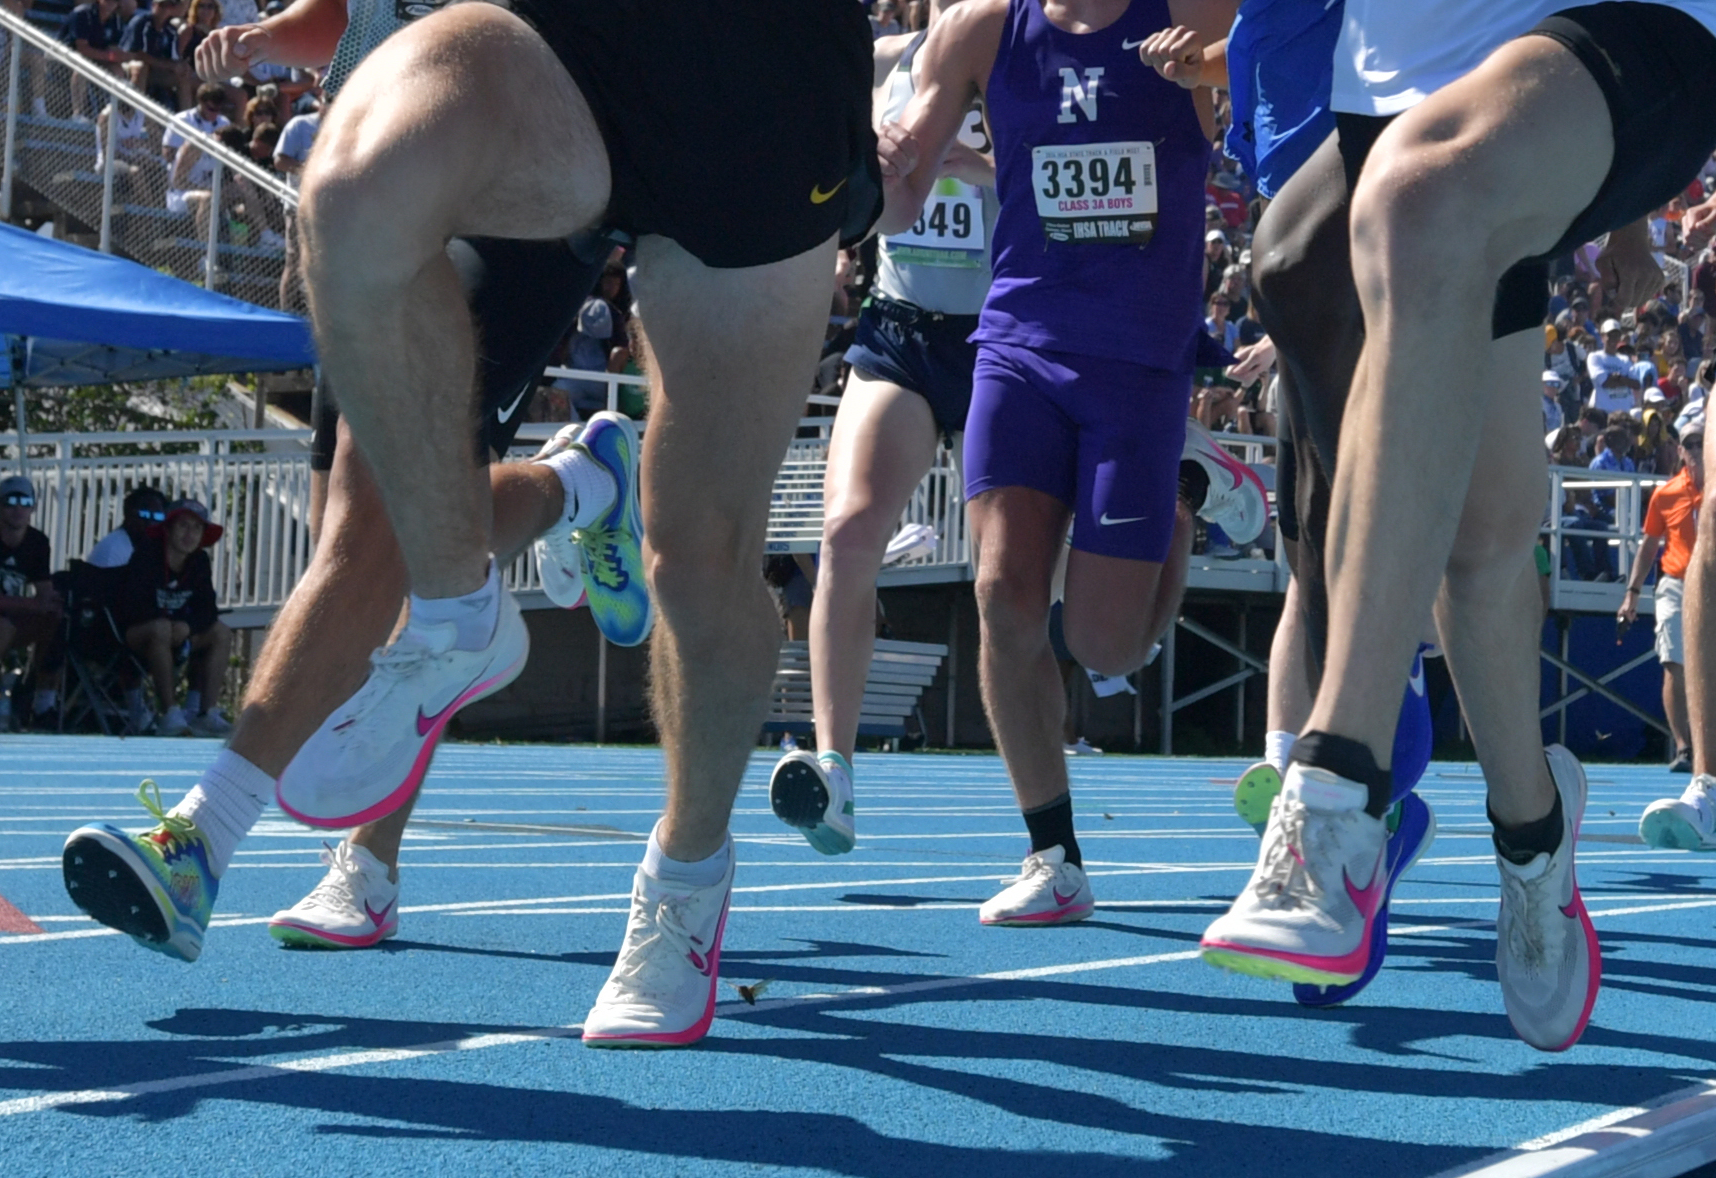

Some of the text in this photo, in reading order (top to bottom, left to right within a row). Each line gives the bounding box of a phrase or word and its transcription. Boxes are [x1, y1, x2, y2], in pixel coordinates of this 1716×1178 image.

[1056, 66, 1105, 124] N
[1041, 156, 1137, 200] 3394
[912, 202, 971, 239] 349
[1058, 197, 1134, 212] CLASS 3A BOYS
[1072, 221, 1098, 240] IHSA
[1096, 219, 1130, 238] TRACK
